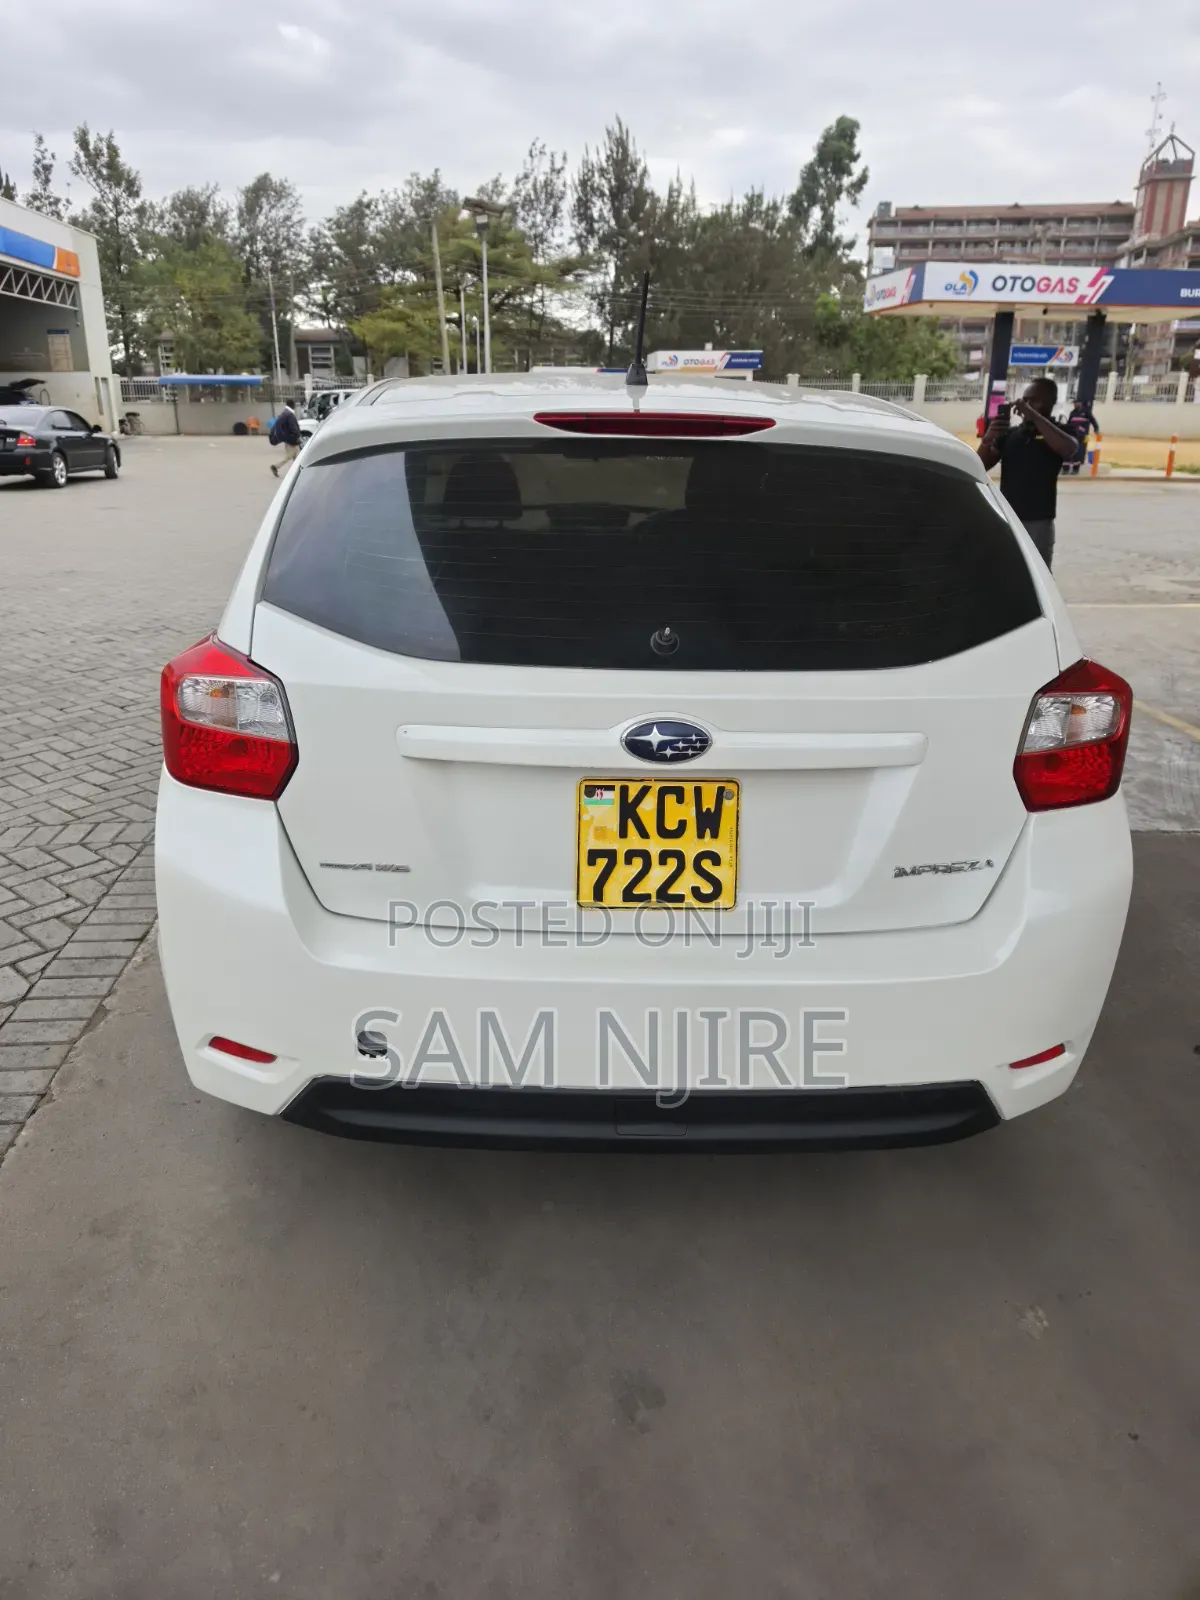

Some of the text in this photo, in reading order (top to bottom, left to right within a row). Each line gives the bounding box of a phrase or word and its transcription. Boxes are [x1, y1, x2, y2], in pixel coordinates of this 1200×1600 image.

[944, 283, 967, 291] OLA
[991, 275, 1080, 294] OTOGAS
[683, 358, 715, 366] OTOGAS
[618, 784, 726, 840] KCW
[587, 848, 723, 903] 722S
[893, 859, 995, 878] IMPREZA
